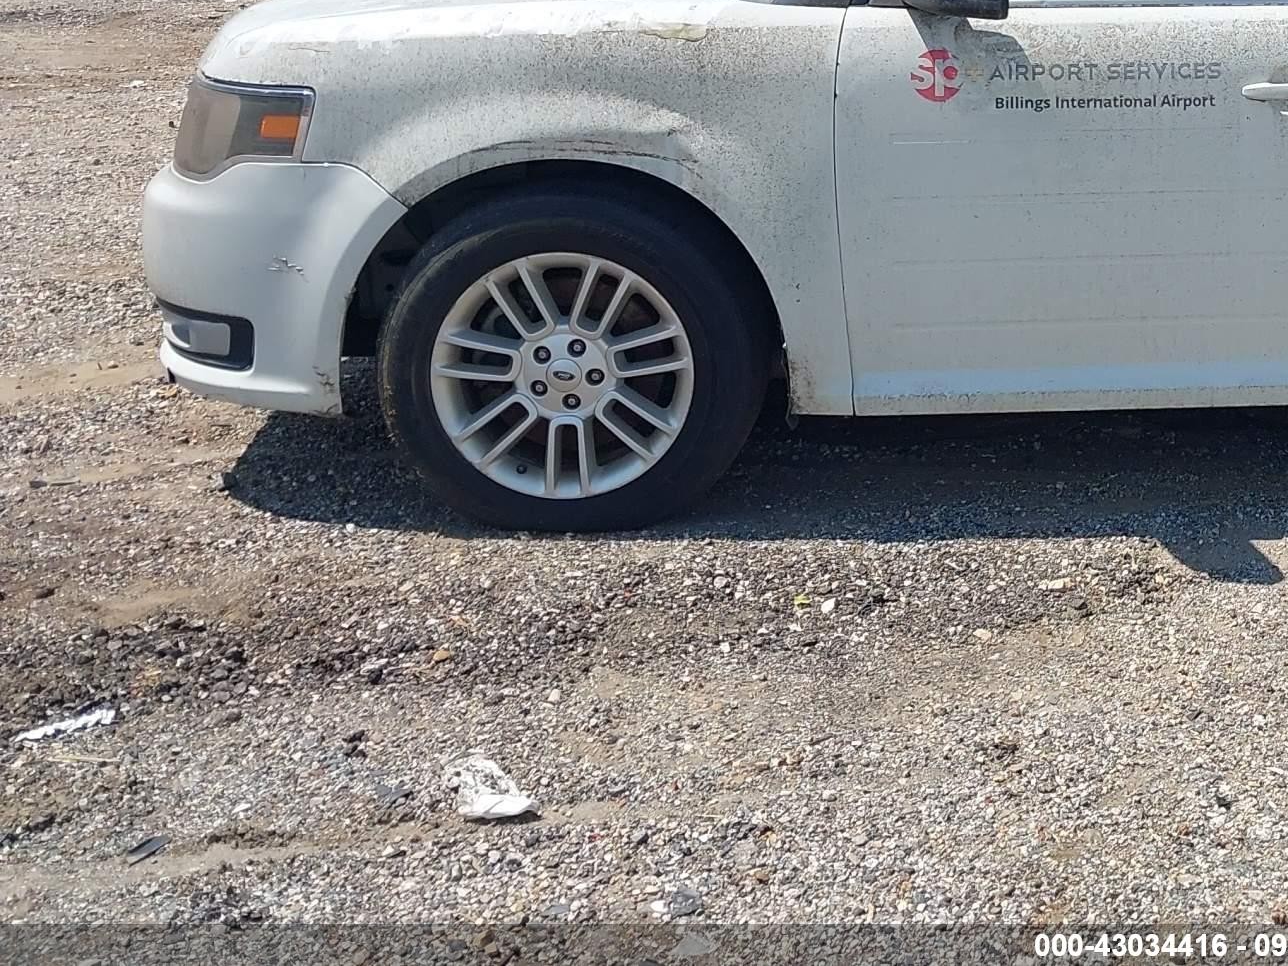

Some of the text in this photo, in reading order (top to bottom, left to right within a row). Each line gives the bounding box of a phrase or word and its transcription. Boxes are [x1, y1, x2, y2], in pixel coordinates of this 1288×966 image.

[990, 62, 1222, 81] AIRPORT SERVICES
[995, 93, 1217, 113] Billings International Airport
